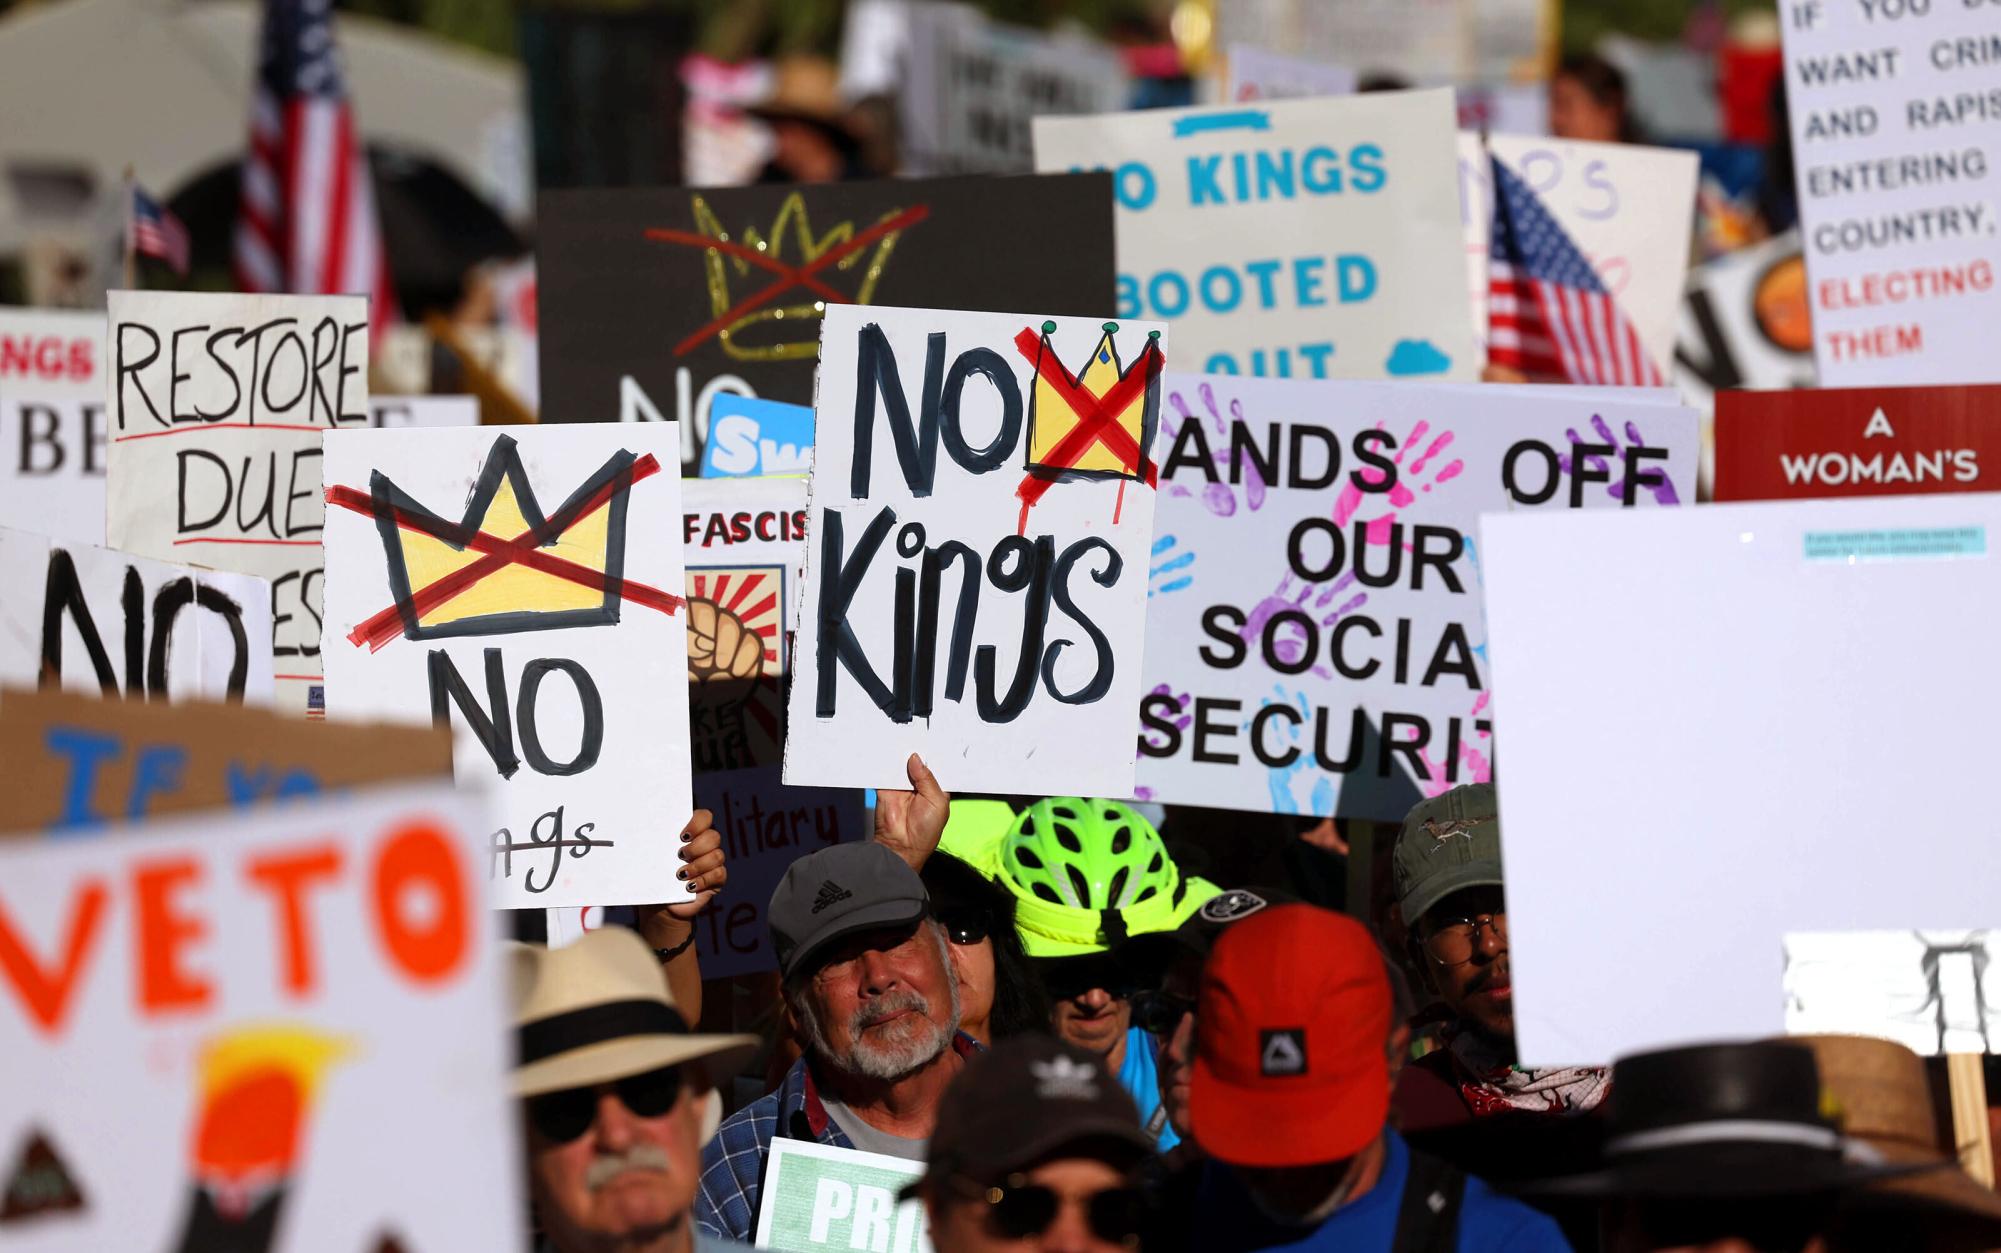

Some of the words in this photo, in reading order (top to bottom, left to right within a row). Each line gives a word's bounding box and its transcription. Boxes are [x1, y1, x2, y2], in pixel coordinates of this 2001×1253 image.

[1793, 3, 1822, 29] IF
[1799, 48, 1898, 86] WANT
[1805, 105, 1878, 140] AND
[1188, 145, 1387, 206] KINGS
[1809, 149, 1988, 198] ENTERING
[1818, 258, 1994, 310] ELECTING
[116, 316, 368, 430] RESTORE
[1825, 323, 1923, 363] THEM
[851, 322, 1024, 499] NO
[1863, 407, 1894, 438] A
[177, 449, 323, 540] DUE
[1502, 438, 1670, 508] OFF
[1780, 450, 1980, 485] WOMAN'S
[1286, 516, 1467, 594] OUR
[38, 547, 249, 706] NO
[815, 505, 1124, 726] Kings
[1198, 604, 1482, 690] SOCIA
[429, 647, 604, 780] NO
[0, 814, 472, 1036] VETO
[809, 1177, 934, 1253] PRI
